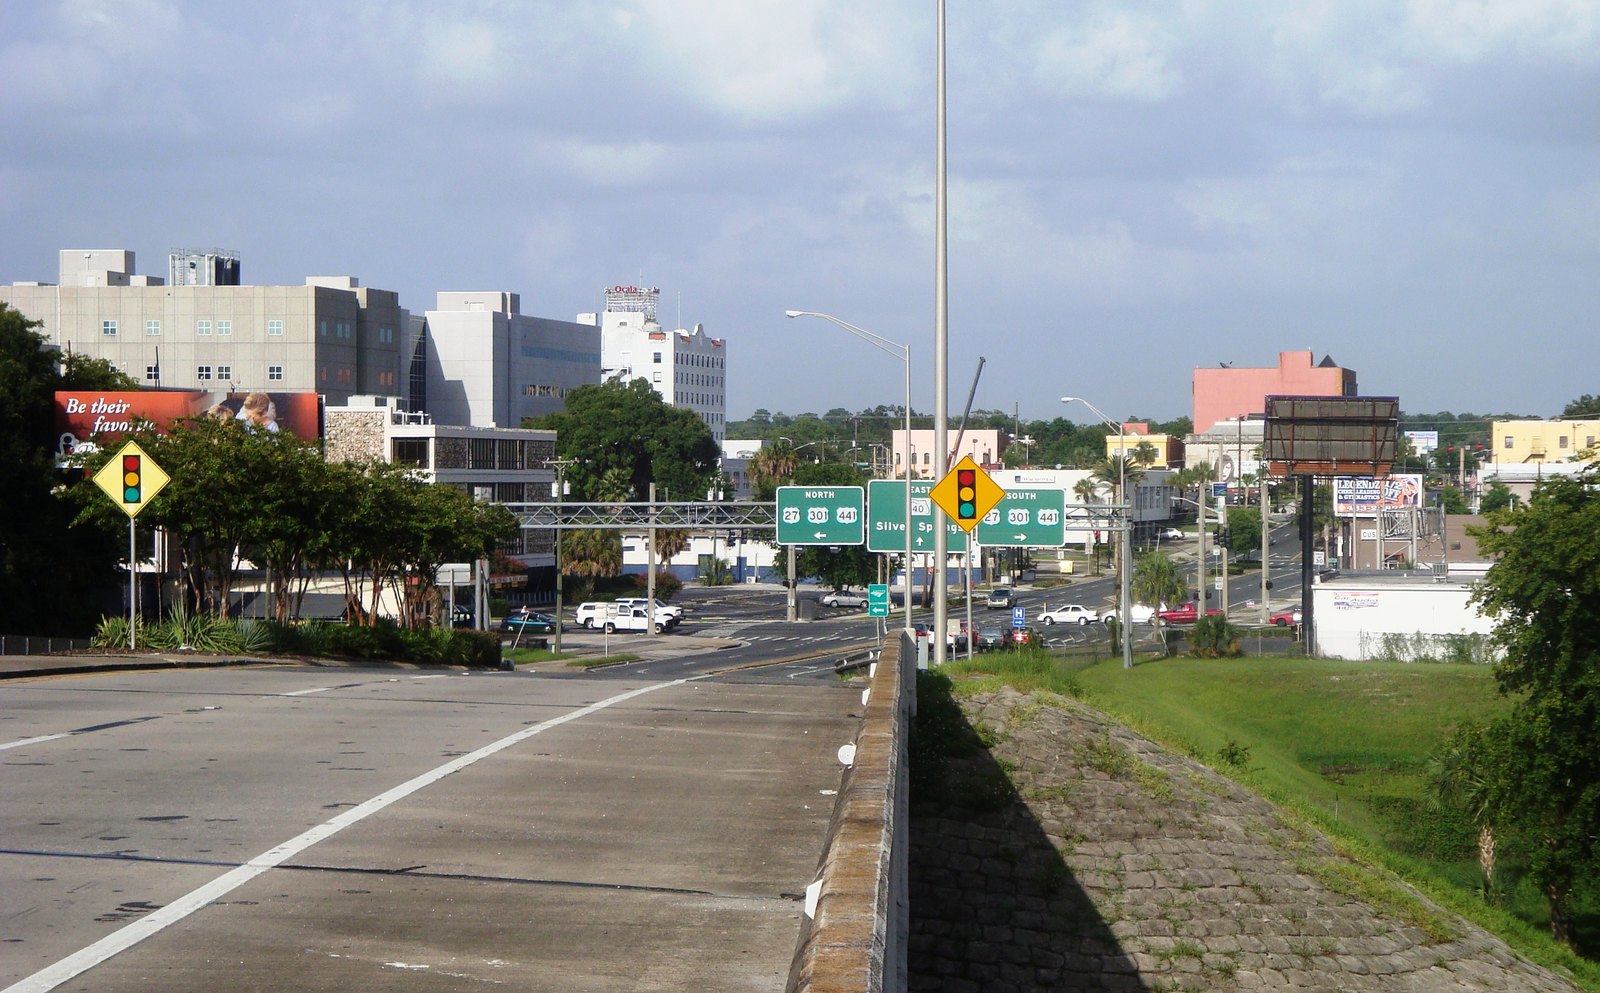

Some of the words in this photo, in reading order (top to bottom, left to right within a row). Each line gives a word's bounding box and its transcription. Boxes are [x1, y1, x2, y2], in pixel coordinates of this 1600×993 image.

[66, 398, 87, 414] Be
[90, 397, 130, 414] their
[805, 491, 835, 499] NORTH
[911, 486, 932, 494] EAST
[1006, 492, 1037, 500] SOUTH
[912, 505, 924, 513] 40
[784, 510, 798, 521] 27
[809, 510, 827, 521] 301
[838, 511, 856, 521] 441
[984, 512, 999, 522] 27
[1009, 512, 1028, 522] 301
[1039, 513, 1057, 522] 441
[876, 521, 906, 531] Silve
[918, 522, 964, 535] Spngs
[1015, 608, 1023, 618] H
